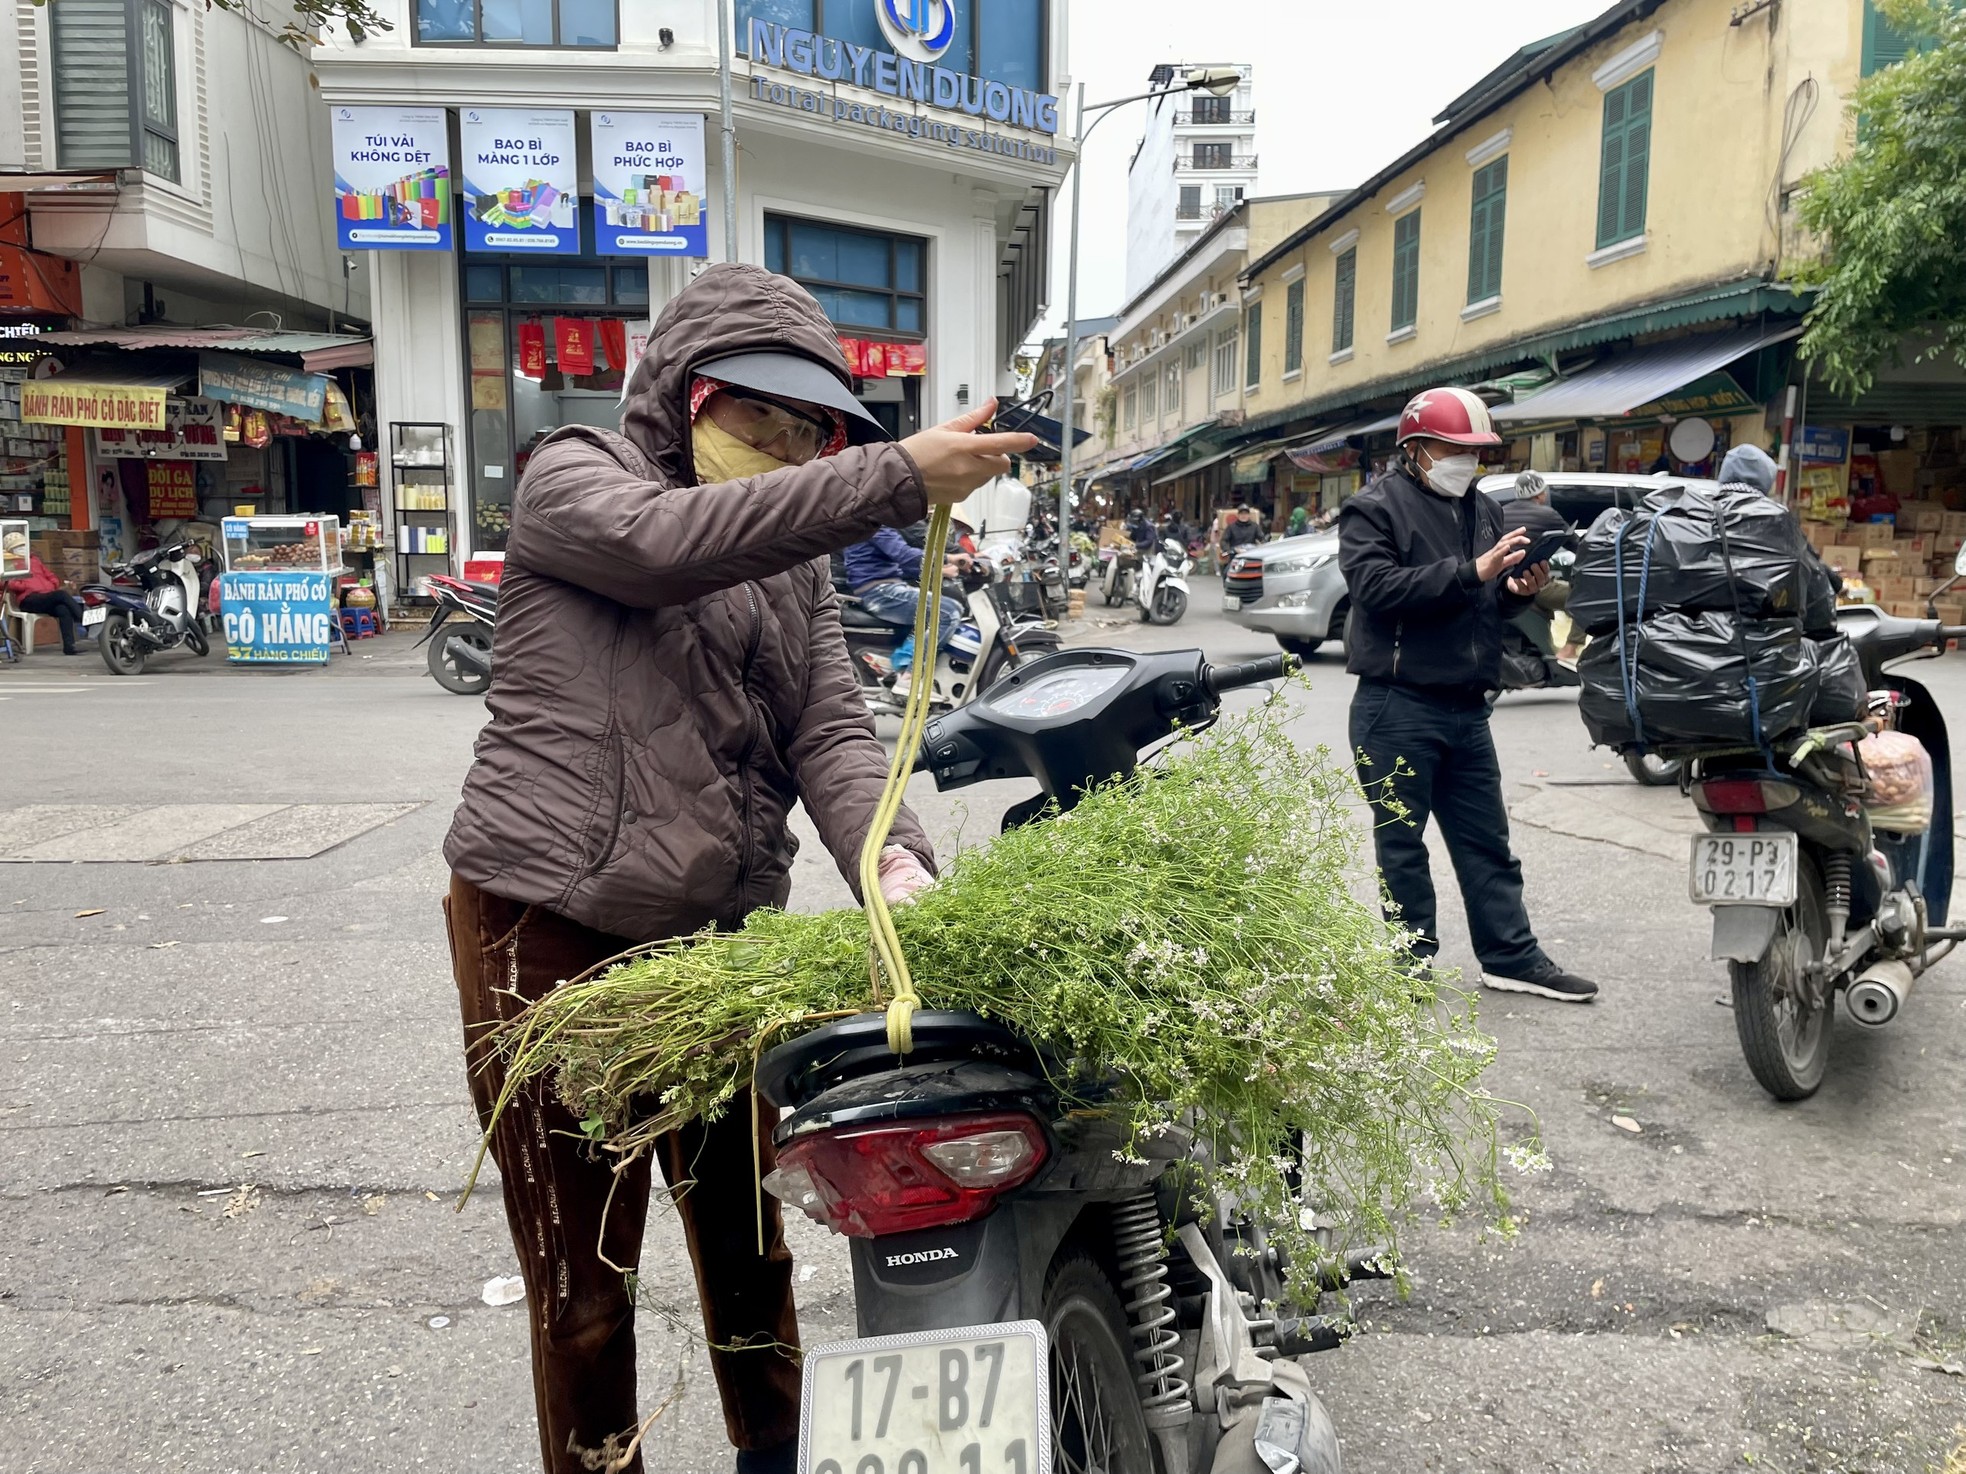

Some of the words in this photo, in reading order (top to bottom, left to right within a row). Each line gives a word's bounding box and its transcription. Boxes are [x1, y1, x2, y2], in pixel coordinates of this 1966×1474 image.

[752, 76, 826, 113] Total
[833, 98, 961, 148] packaging
[967, 131, 1057, 166] solution
[366, 133, 387, 147] TÚI
[391, 133, 414, 148] VẢI
[494, 139, 524, 150] BAO
[529, 137, 542, 150] BÌ
[625, 141, 654, 152] BAO
[658, 140, 672, 153] BÌ
[351, 149, 400, 162] KHÔNG
[404, 150, 431, 165] DỆT
[478, 152, 519, 164] MÀNG
[524, 155, 529, 165] 1
[532, 153, 559, 166] LỚP
[614, 154, 651, 167] PHỨC
[655, 157, 684, 170] HỢP
[24, 390, 48, 417] BÁNH
[51, 391, 73, 419] RÁN
[77, 390, 98, 419] PHỐ
[117, 396, 136, 427] ĐẶC
[139, 397, 161, 428] BIỆT
[174, 470, 192, 484] GA
[150, 486, 164, 497] DU
[224, 579, 256, 601] BÁNH
[258, 578, 282, 601] RÁN
[285, 577, 309, 601] PHỐ
[223, 606, 255, 644] CÔ
[262, 602, 328, 645] HẰNG
[228, 646, 252, 659] 57
[253, 648, 288, 660] HÀNG
[291, 646, 328, 661] CHIẾU
[1707, 840, 1779, 866] 29-P3
[1705, 869, 1775, 896] 0217
[886, 1247, 959, 1267] HONDA
[844, 1342, 1005, 1442] 17-B7
